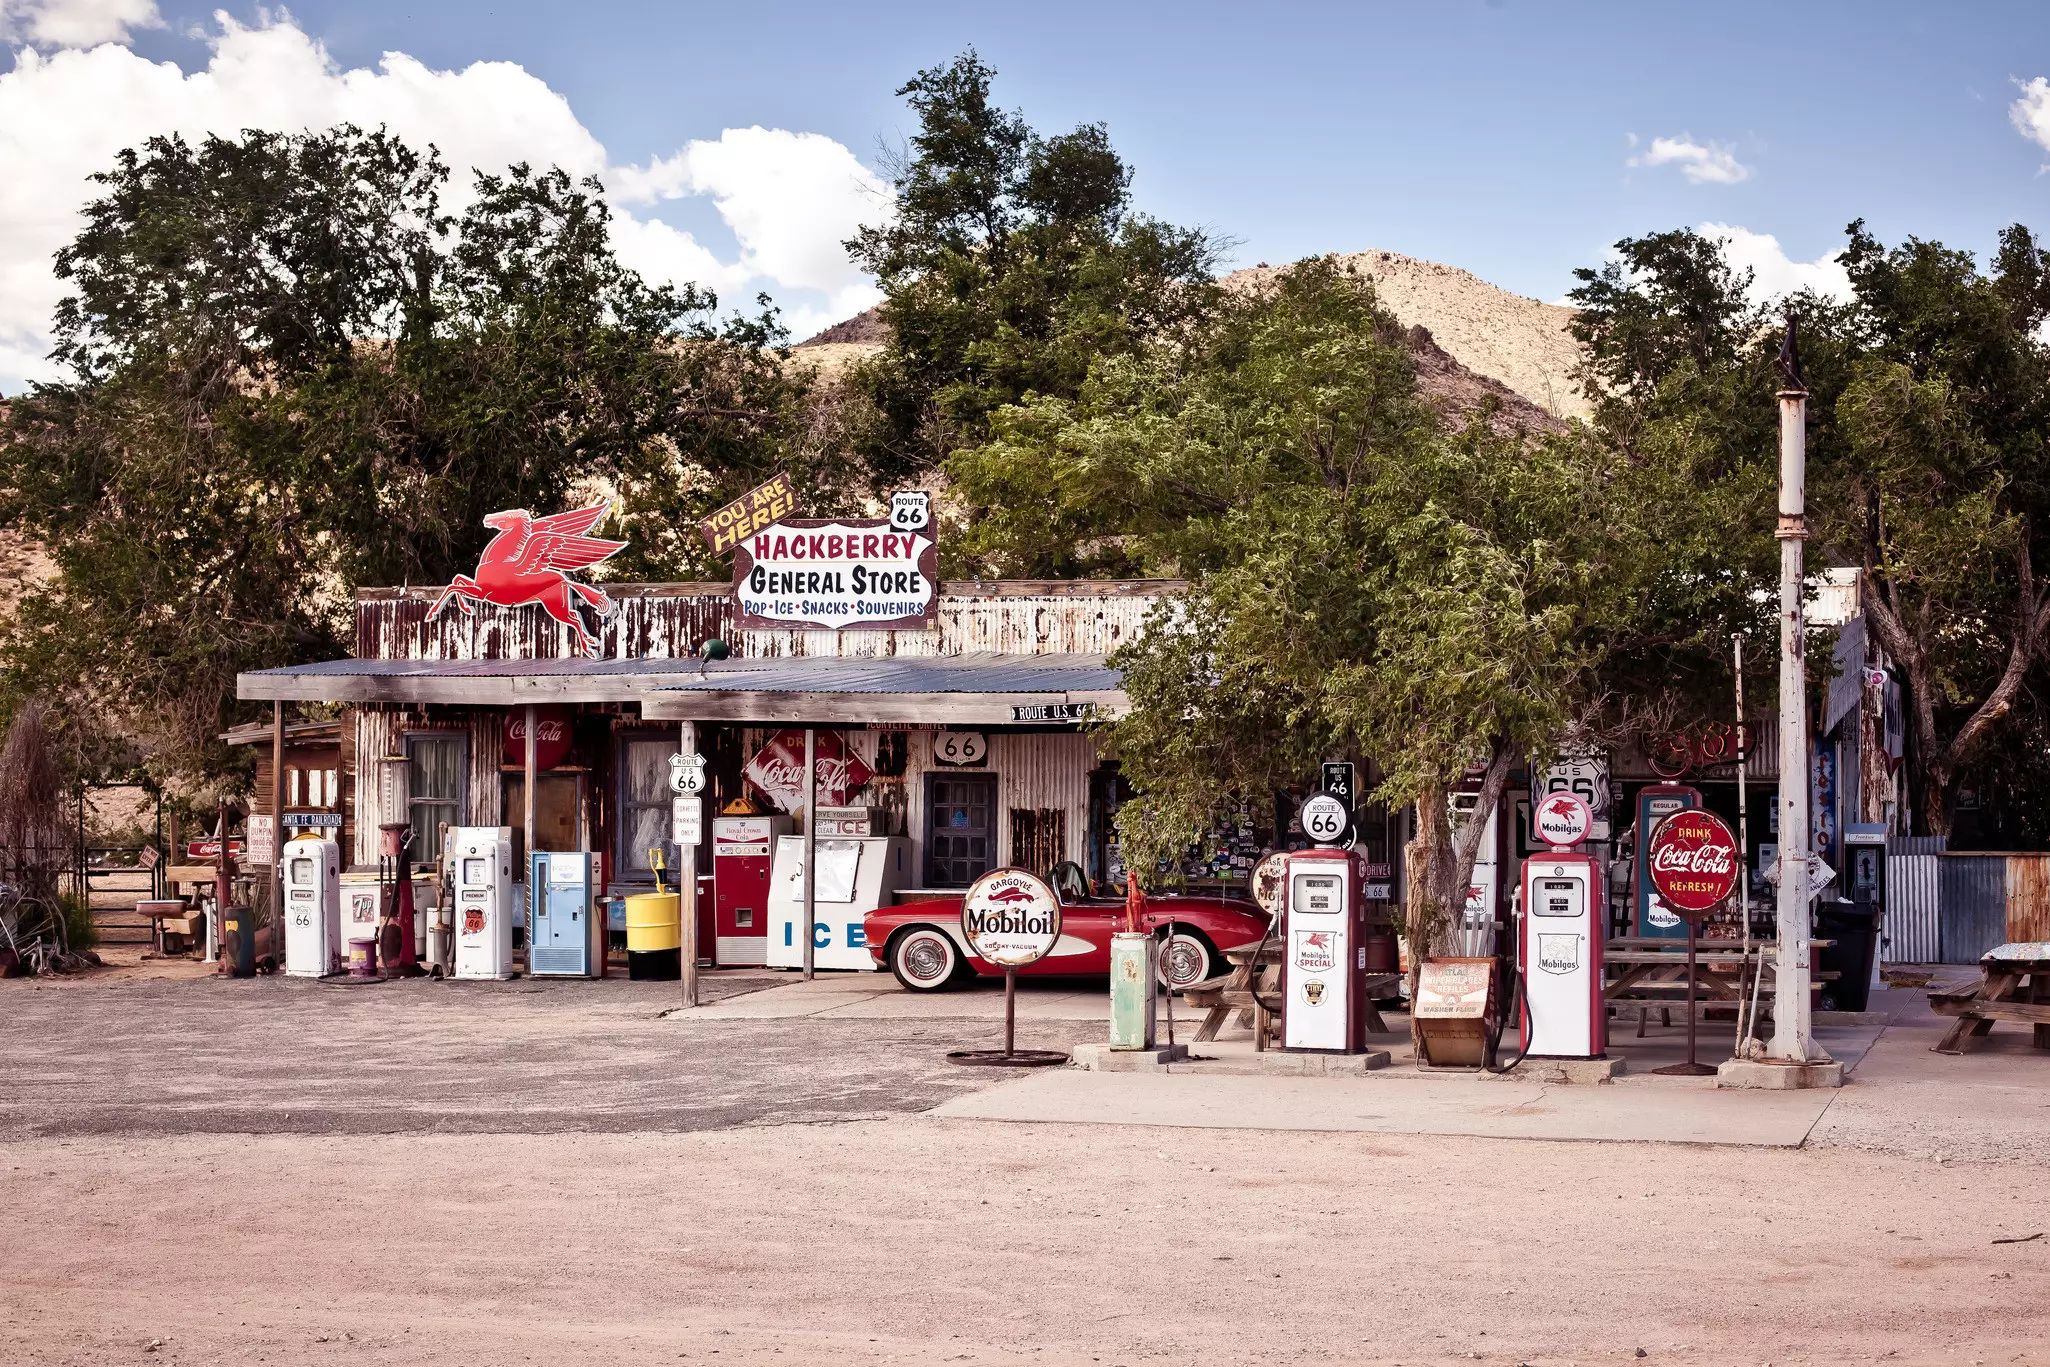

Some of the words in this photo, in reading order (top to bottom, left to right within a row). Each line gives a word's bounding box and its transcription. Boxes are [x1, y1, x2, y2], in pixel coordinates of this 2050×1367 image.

[706, 501, 746, 532] YOU
[753, 479, 786, 509] ARE
[895, 498, 924, 506] ROUTE
[714, 492, 794, 552] HERE!
[896, 508, 922, 524] 66
[754, 532, 917, 560] HACKBERRY
[750, 564, 845, 595] GENERAL
[851, 564, 921, 595] STORE
[802, 600, 848, 615] SNACKS
[856, 600, 924, 616] SOUVENIRS
[1019, 706, 1048, 720] ROUTE
[1053, 705, 1071, 719] U.S.
[786, 736, 827, 748] DRK
[944, 736, 975, 757] 66
[1558, 767, 1581, 776] US
[678, 775, 697, 789] 66
[1330, 782, 1347, 795] 66
[1312, 804, 1336, 812] ROUTE
[258, 818, 268, 827] NO
[283, 815, 298, 824] ANTA
[301, 815, 308, 824] FE
[311, 815, 339, 824] RAILROAD
[1312, 814, 1337, 833] 66
[251, 827, 273, 836] DUMPIN
[726, 827, 742, 835] Royal
[836, 821, 867, 834] ICE
[1541, 823, 1582, 835] Mobilgas
[1678, 828, 1711, 838] DRINK
[1654, 843, 1732, 874] Coca-Cola
[1367, 865, 1387, 876] DRIVE
[990, 878, 1033, 891] GARGOYLE
[1373, 886, 1383, 896] 66
[295, 914, 310, 926] 66
[468, 919, 480, 929] 66
[967, 907, 1055, 935] Mobiloil
[1650, 914, 1680, 924] Mobilgas
[784, 922, 865, 949] ICE
[1301, 952, 1330, 960] Mobilgas
[1300, 959, 1331, 967] SPECIAL
[1541, 959, 1576, 970] Mobilgas
